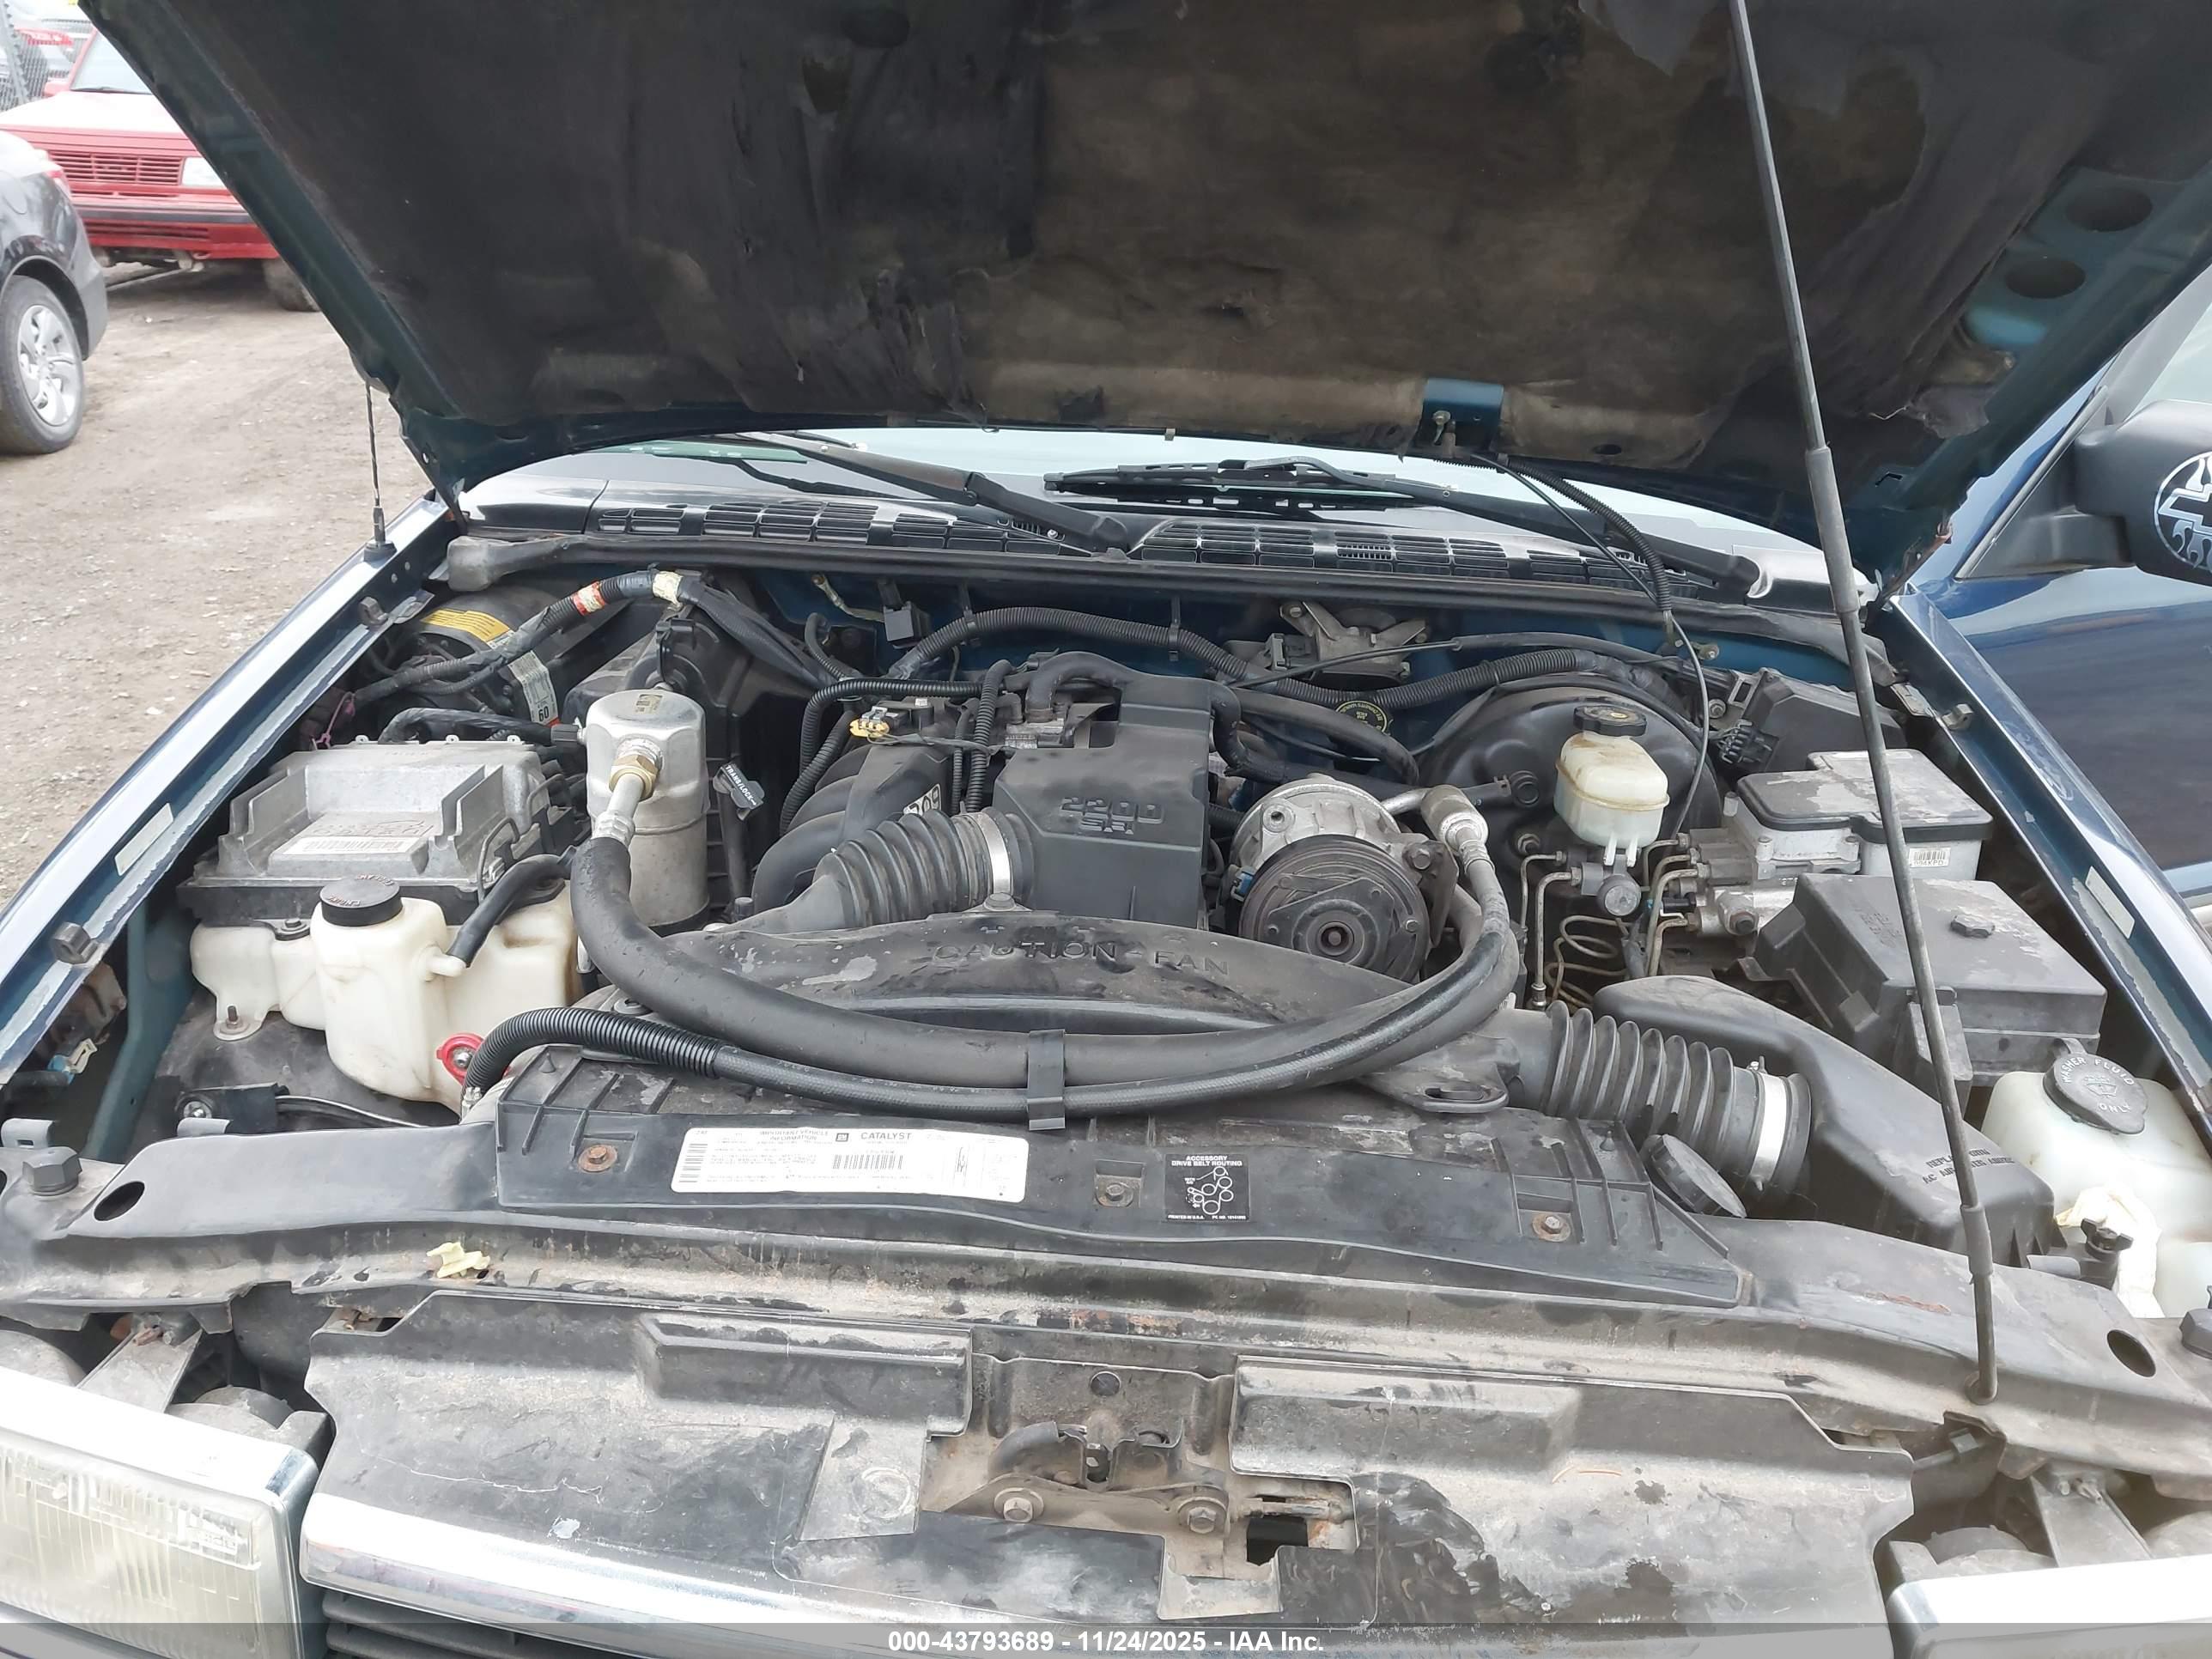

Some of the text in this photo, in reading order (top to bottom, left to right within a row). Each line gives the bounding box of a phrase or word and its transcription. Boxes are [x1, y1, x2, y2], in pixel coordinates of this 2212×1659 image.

[726, 764, 754, 801] TRANS/LOCK
[1060, 797, 1165, 824] 2200
[933, 941, 1116, 963] CAUTION
[1152, 951, 1230, 975] FAN
[2061, 1057, 2135, 1085] WASHER FLUID
[2099, 1102, 2130, 1113] ONLY
[860, 1132, 912, 1140] CATALYST
